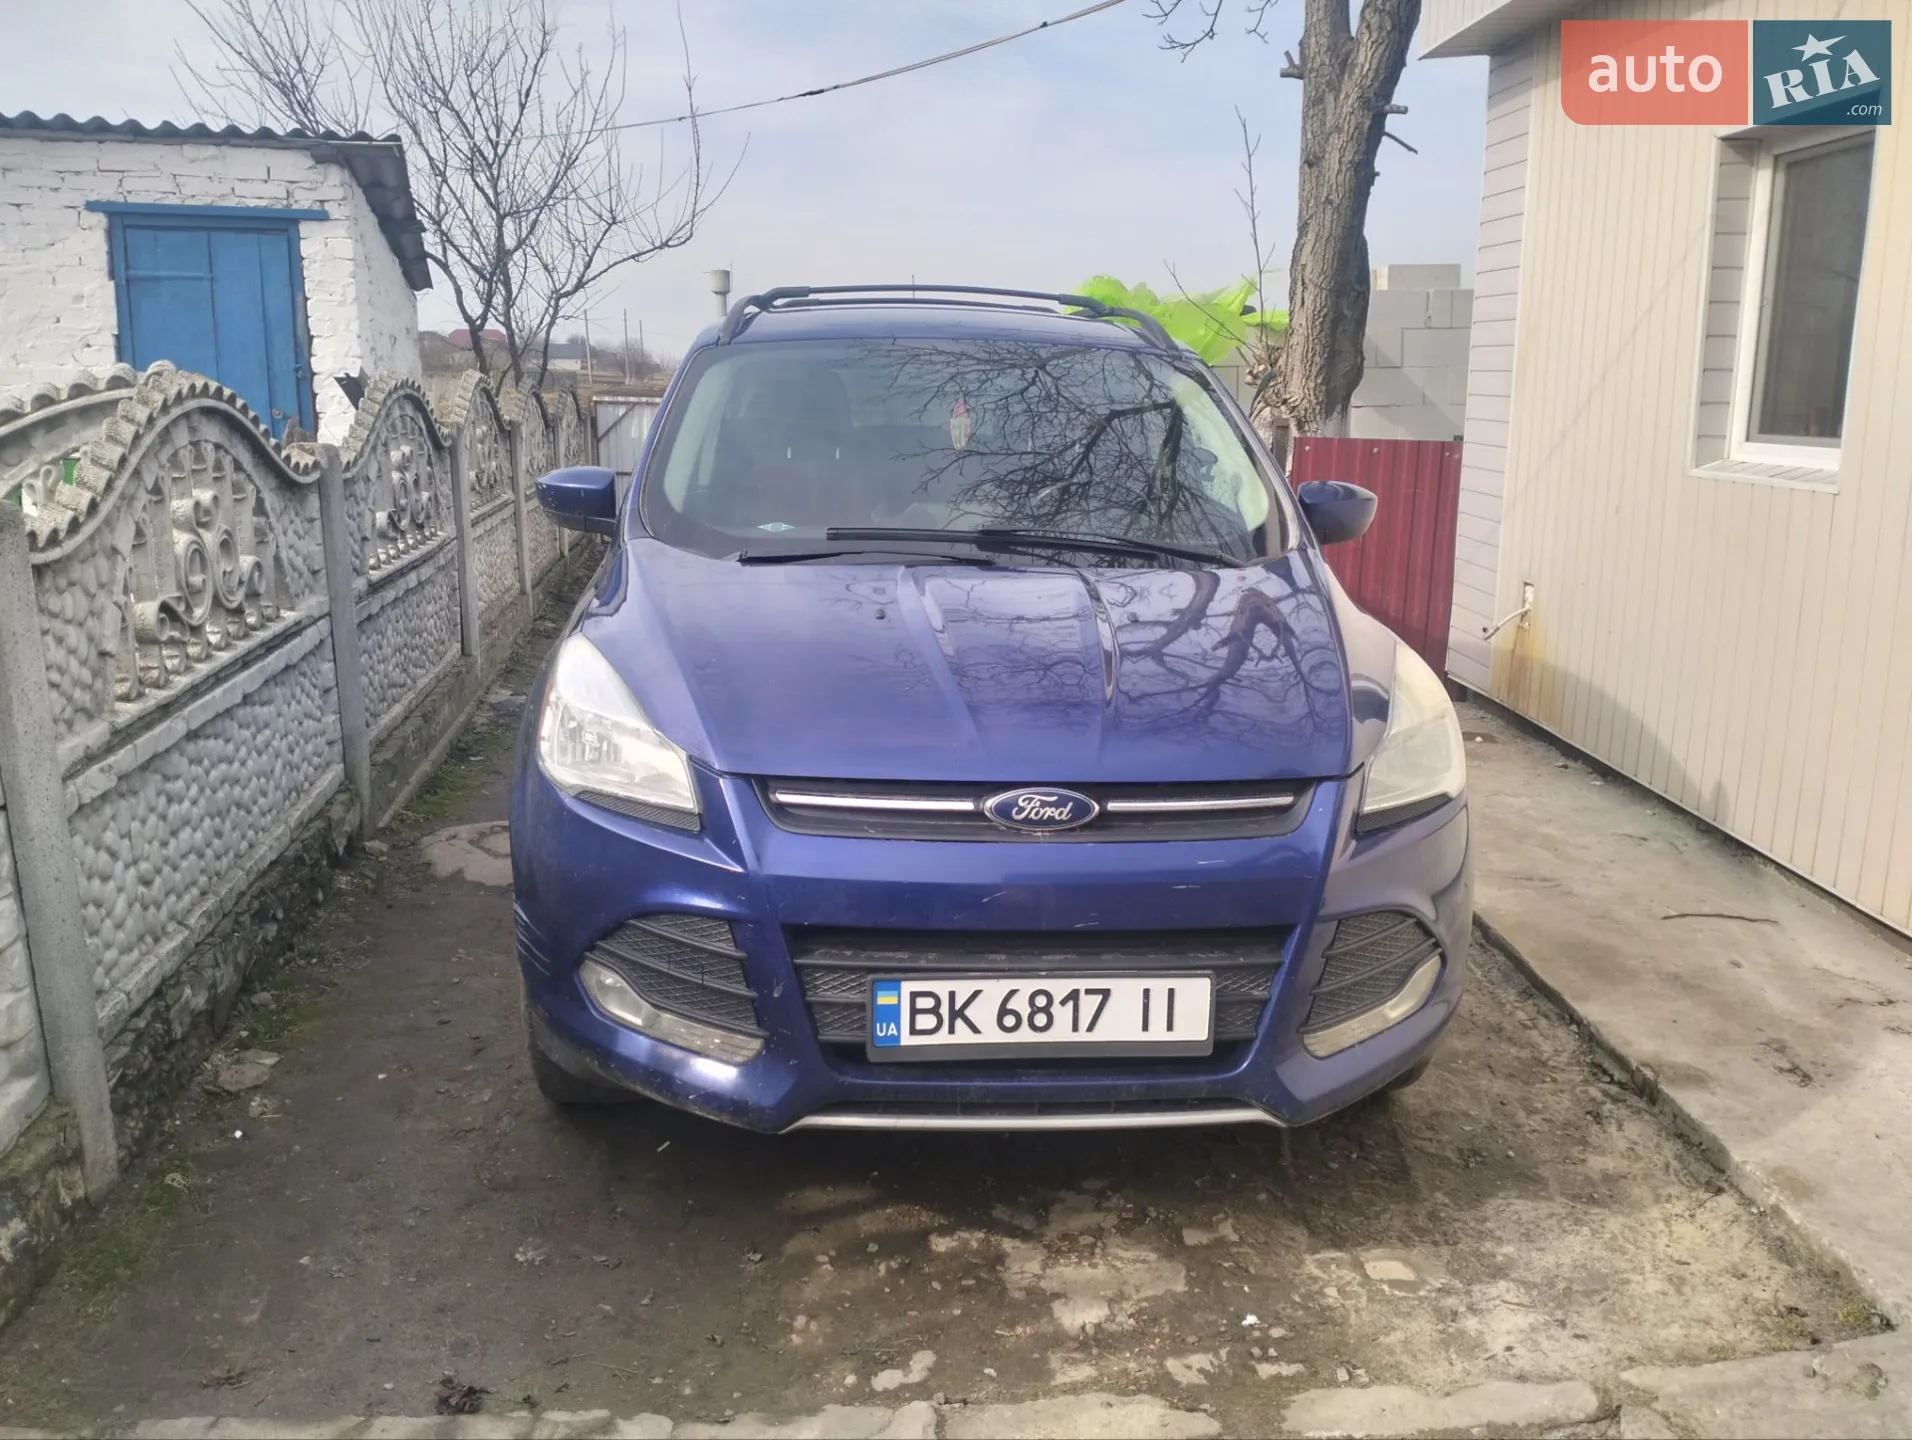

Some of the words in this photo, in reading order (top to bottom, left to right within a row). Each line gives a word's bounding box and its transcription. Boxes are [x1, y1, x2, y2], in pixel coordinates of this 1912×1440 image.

[1011, 794, 1074, 820] Ford
[908, 989, 984, 1036] BK
[996, 988, 1111, 1033] 6817
[1141, 987, 1175, 1032] II
[876, 1022, 898, 1037] UA
